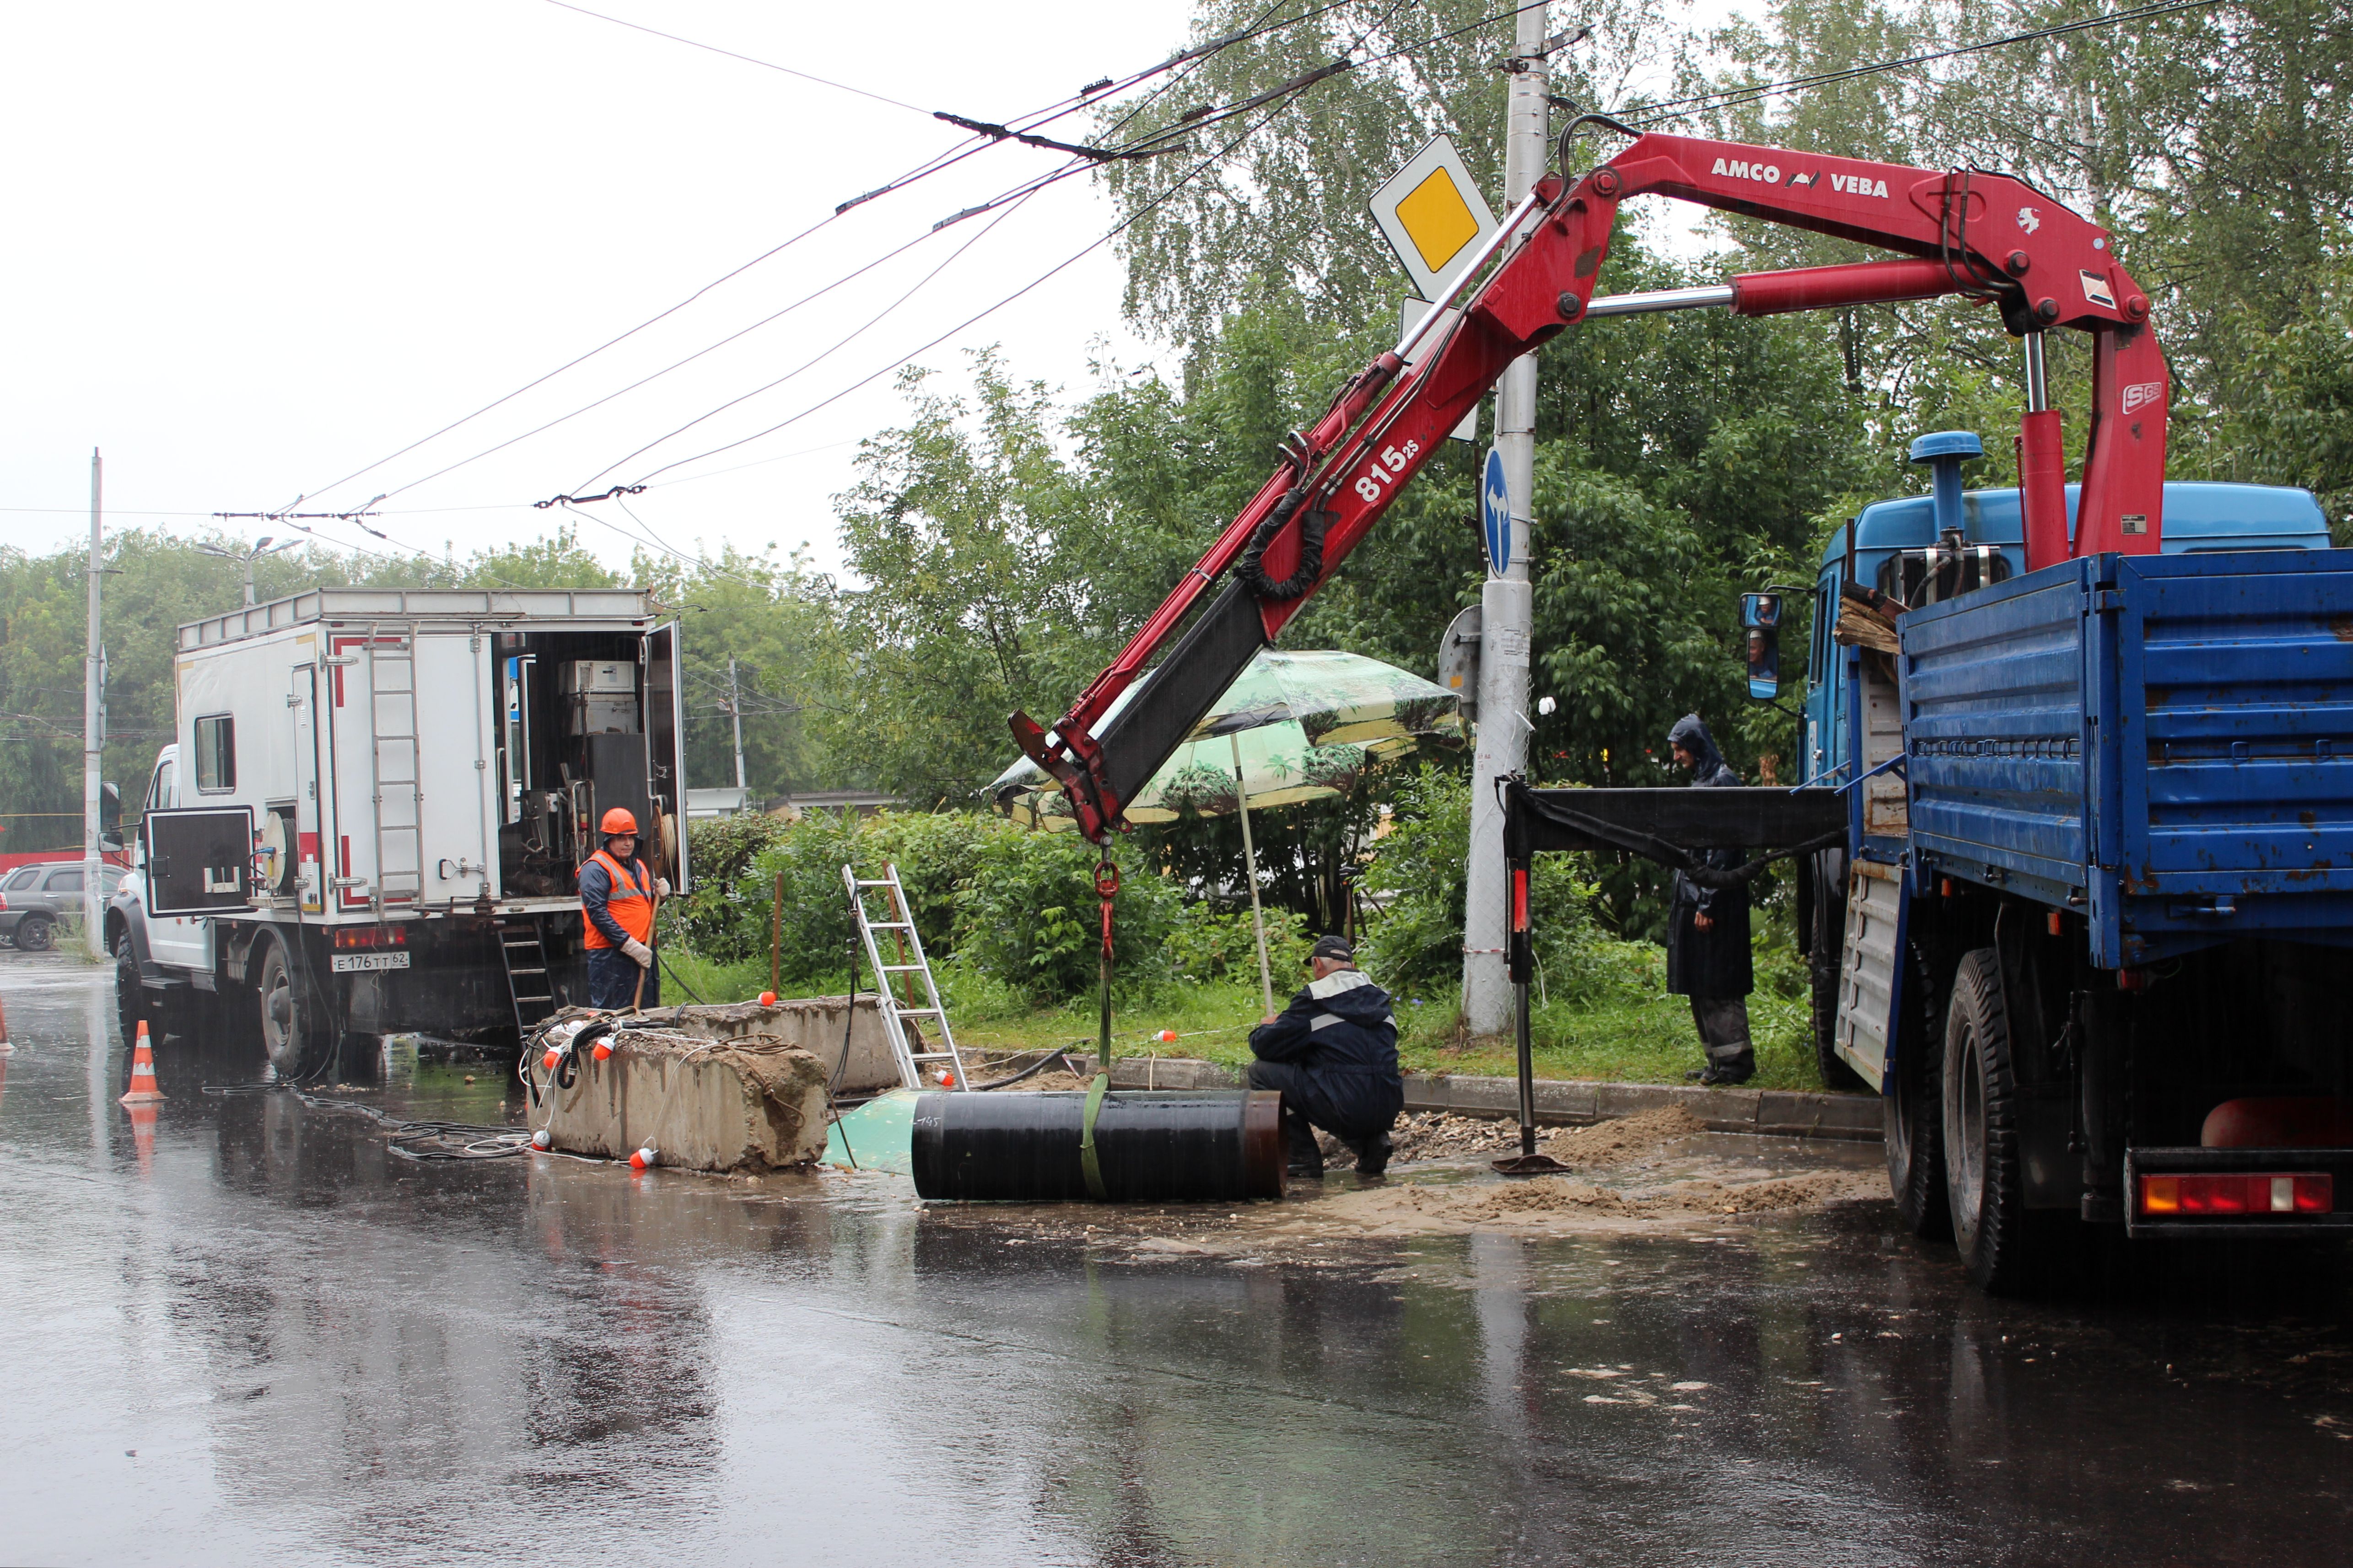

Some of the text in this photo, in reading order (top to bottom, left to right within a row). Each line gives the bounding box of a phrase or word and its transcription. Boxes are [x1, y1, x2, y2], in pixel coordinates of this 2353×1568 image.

[1711, 157, 1889, 198] AMCO VEBA
[393, 954, 405, 962] 62
